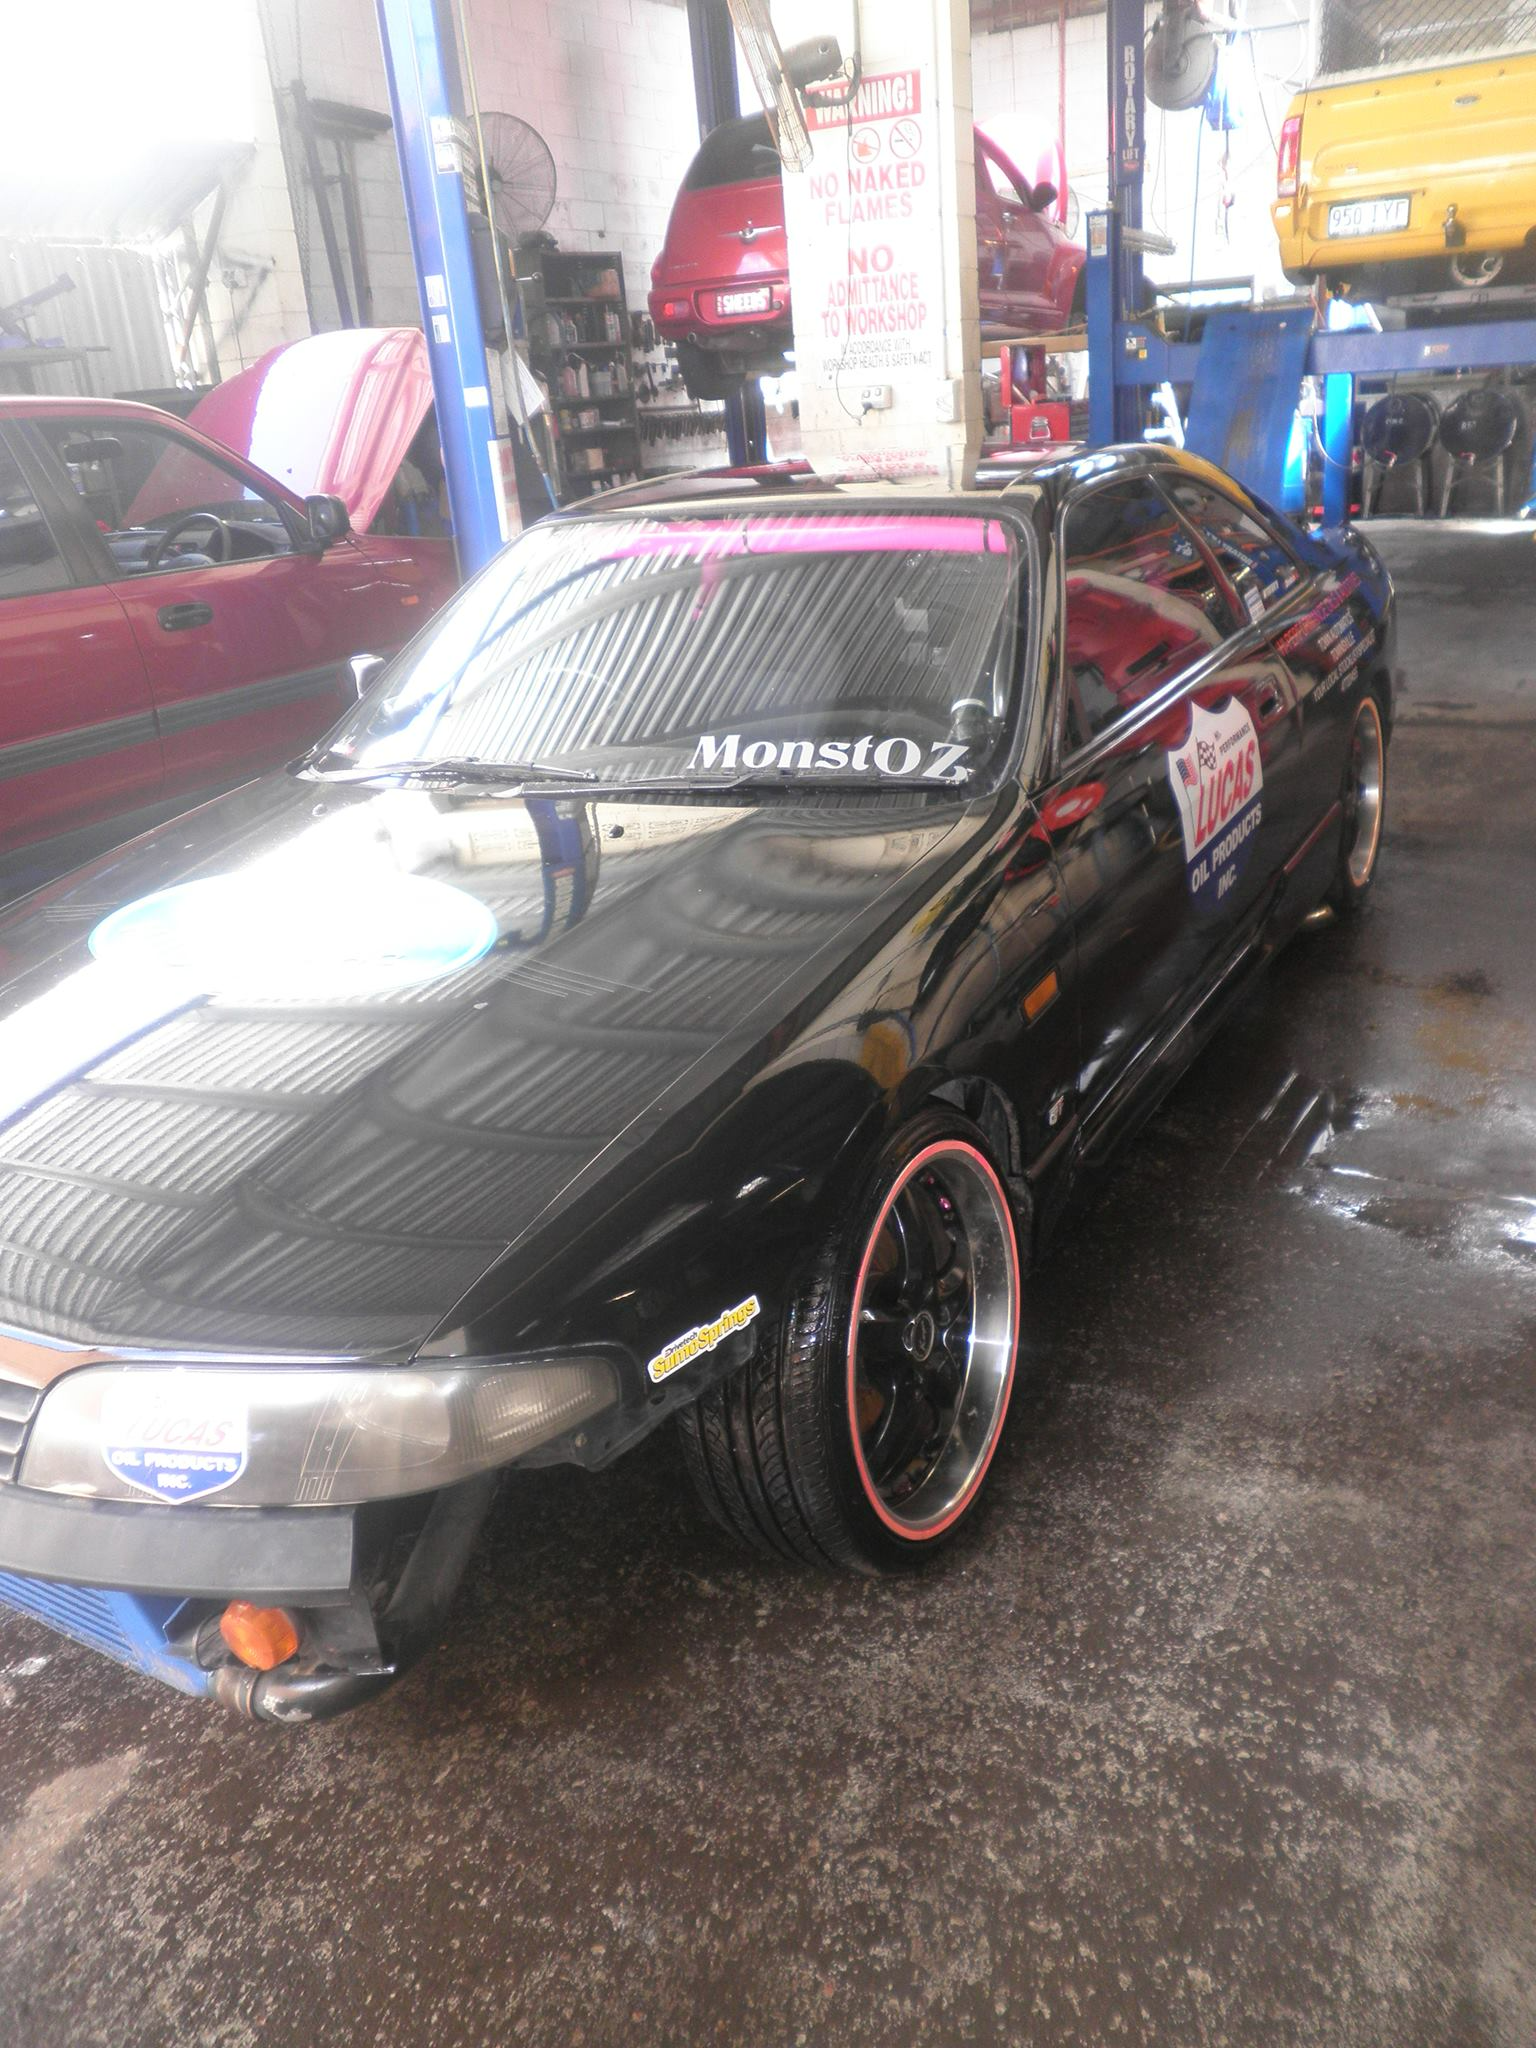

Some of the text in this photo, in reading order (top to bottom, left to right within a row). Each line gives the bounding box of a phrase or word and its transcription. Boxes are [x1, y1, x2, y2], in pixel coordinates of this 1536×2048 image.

[1123, 45, 1136, 147] ROTARY
[1122, 148, 1139, 160] LIFT
[809, 161, 926, 200] NO NAKED
[824, 191, 913, 226] FLAMES
[848, 244, 894, 275] NO
[827, 272, 919, 307] ADMITTANCE
[821, 302, 927, 338] TO WORKSHOP
[686, 734, 975, 785] MonstOZ
[1195, 739, 1255, 848] LUCAS
[1191, 802, 1263, 894] OIL PRODUCTS
[1217, 864, 1237, 899] INC.
[126, 1416, 233, 1447] LUCAS
[111, 1450, 237, 1472] OIL PRODUCTS
[157, 1473, 192, 1489] INC.
